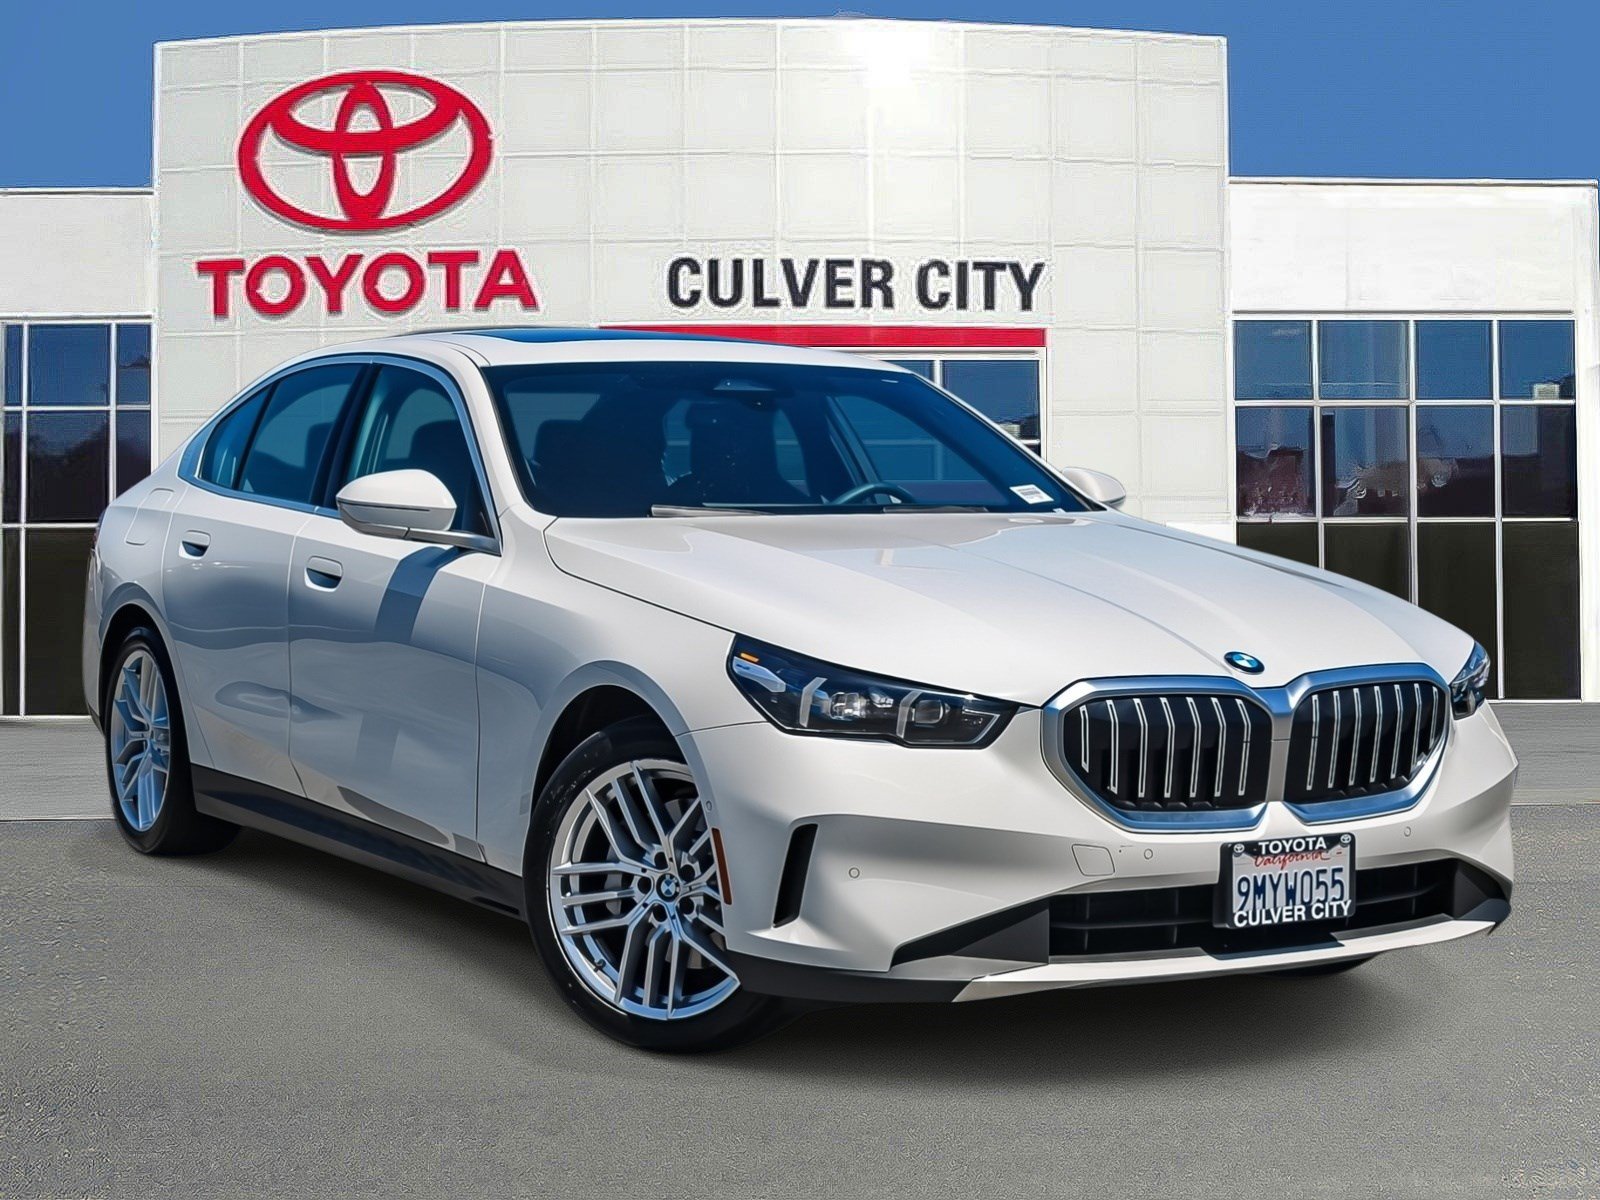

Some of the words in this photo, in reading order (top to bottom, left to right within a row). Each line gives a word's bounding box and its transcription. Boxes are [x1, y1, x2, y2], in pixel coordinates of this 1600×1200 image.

[195, 249, 540, 319] TOYOTA
[667, 257, 895, 310] CULVER
[915, 259, 1046, 312] CITY
[1258, 837, 1327, 854] TOYOTA
[1237, 867, 1345, 911] 9MYW055
[1233, 905, 1306, 927] CULVER
[1311, 899, 1352, 920] CITY
